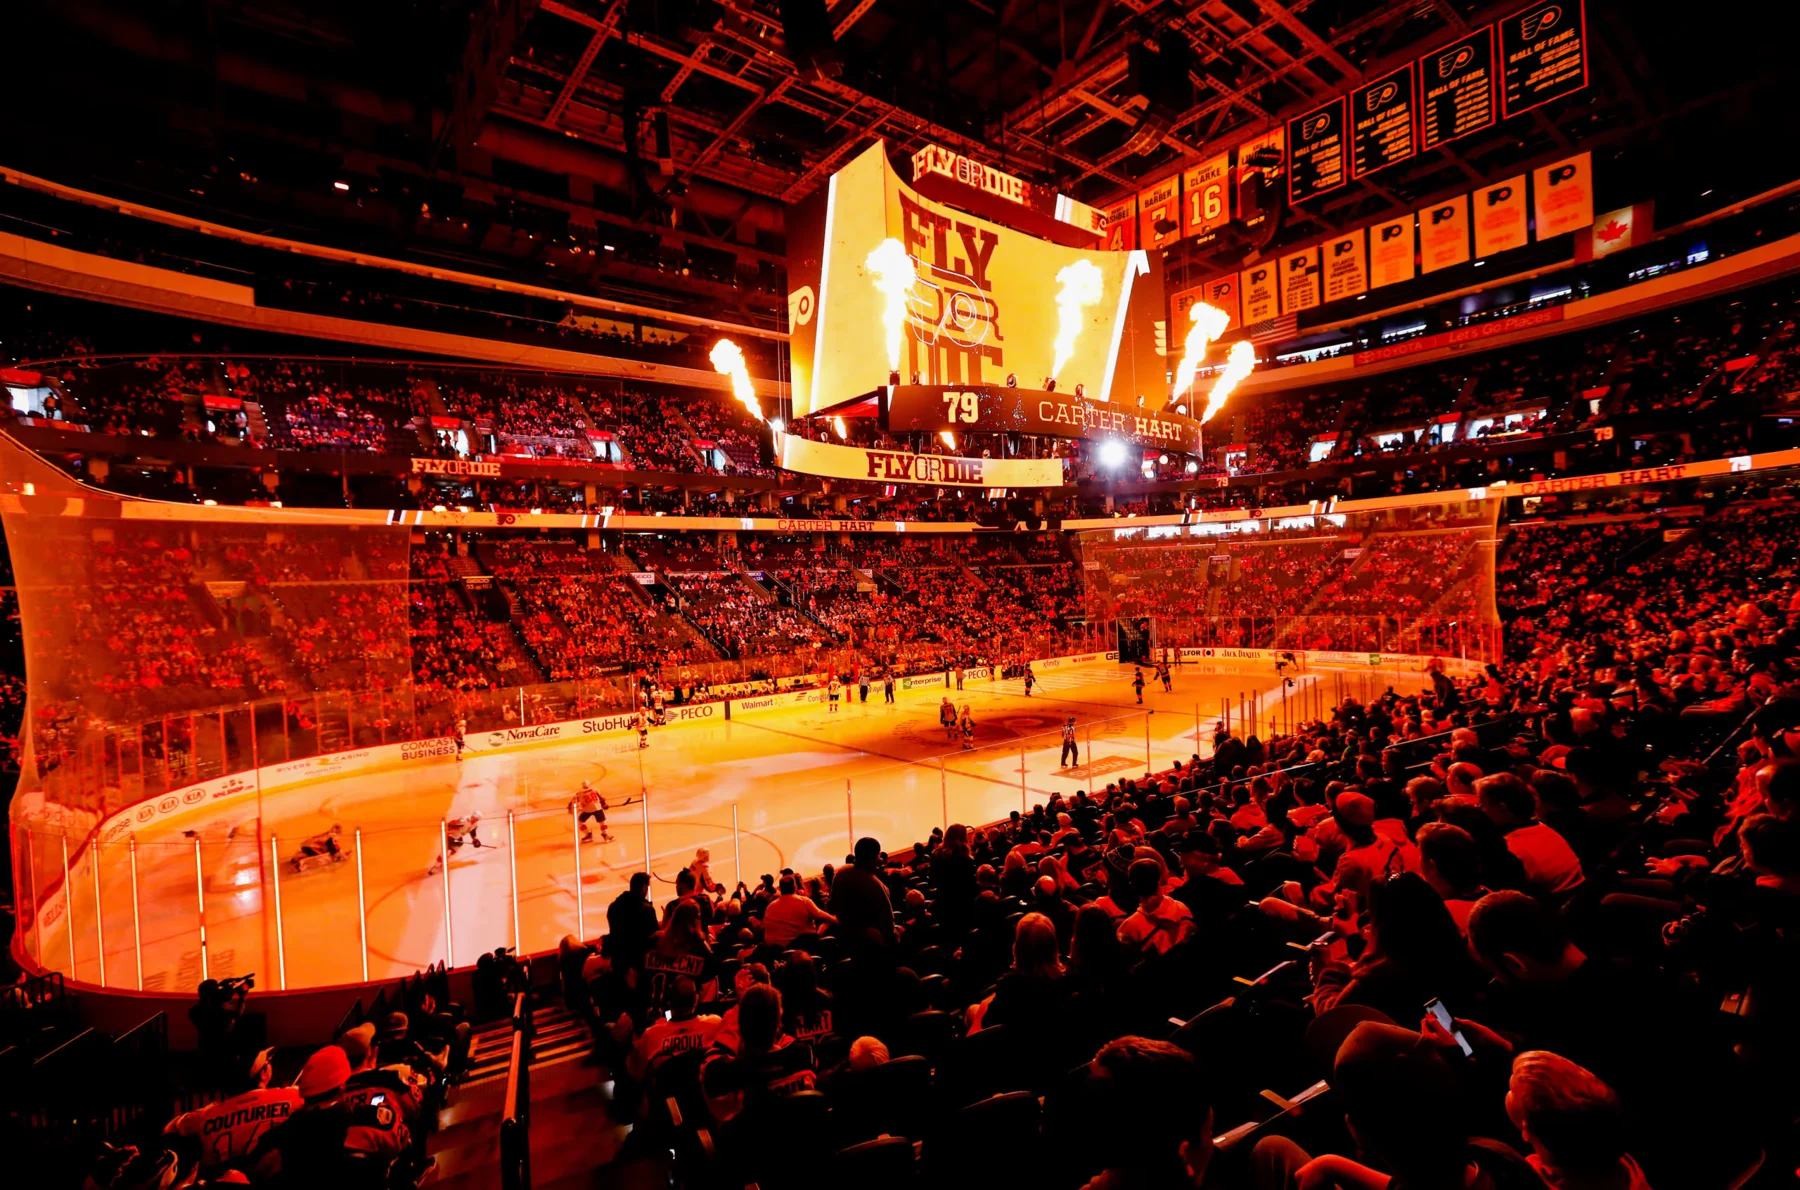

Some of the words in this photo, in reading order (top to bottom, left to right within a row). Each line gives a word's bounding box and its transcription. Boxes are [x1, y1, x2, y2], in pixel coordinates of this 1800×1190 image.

[1534, 40, 1547, 53] OF
[1548, 28, 1575, 46] FAME
[1190, 167, 1221, 187] CLARKE
[1144, 189, 1172, 208] BARBER
[1191, 184, 1221, 226] 16
[900, 190, 999, 292] FLY
[1110, 225, 1124, 251] 4
[1376, 341, 1423, 359] TOYOTA
[1450, 328, 1479, 343] Let's
[1482, 322, 1502, 336] Go
[1505, 311, 1551, 330] Places
[943, 392, 979, 424] 79
[1038, 401, 1126, 432] CARTER
[1134, 416, 1183, 442] HART
[1594, 426, 1614, 441] 79
[1216, 477, 1229, 488] 79
[1521, 474, 1609, 496] CARTER
[1619, 465, 1687, 485] HART
[1728, 456, 1752, 473] 79
[778, 519, 833, 532] CARTER
[839, 520, 875, 532] HART
[968, 669, 988, 680] PECO
[680, 705, 713, 720] PECO
[741, 699, 774, 710] Walmart
[506, 726, 561, 741] NovaCare
[401, 738, 456, 752] COMCAST
[401, 746, 456, 761] BUSINESS
[662, 1033, 703, 1052] GIROUX
[203, 1102, 291, 1135] COUTURIER
